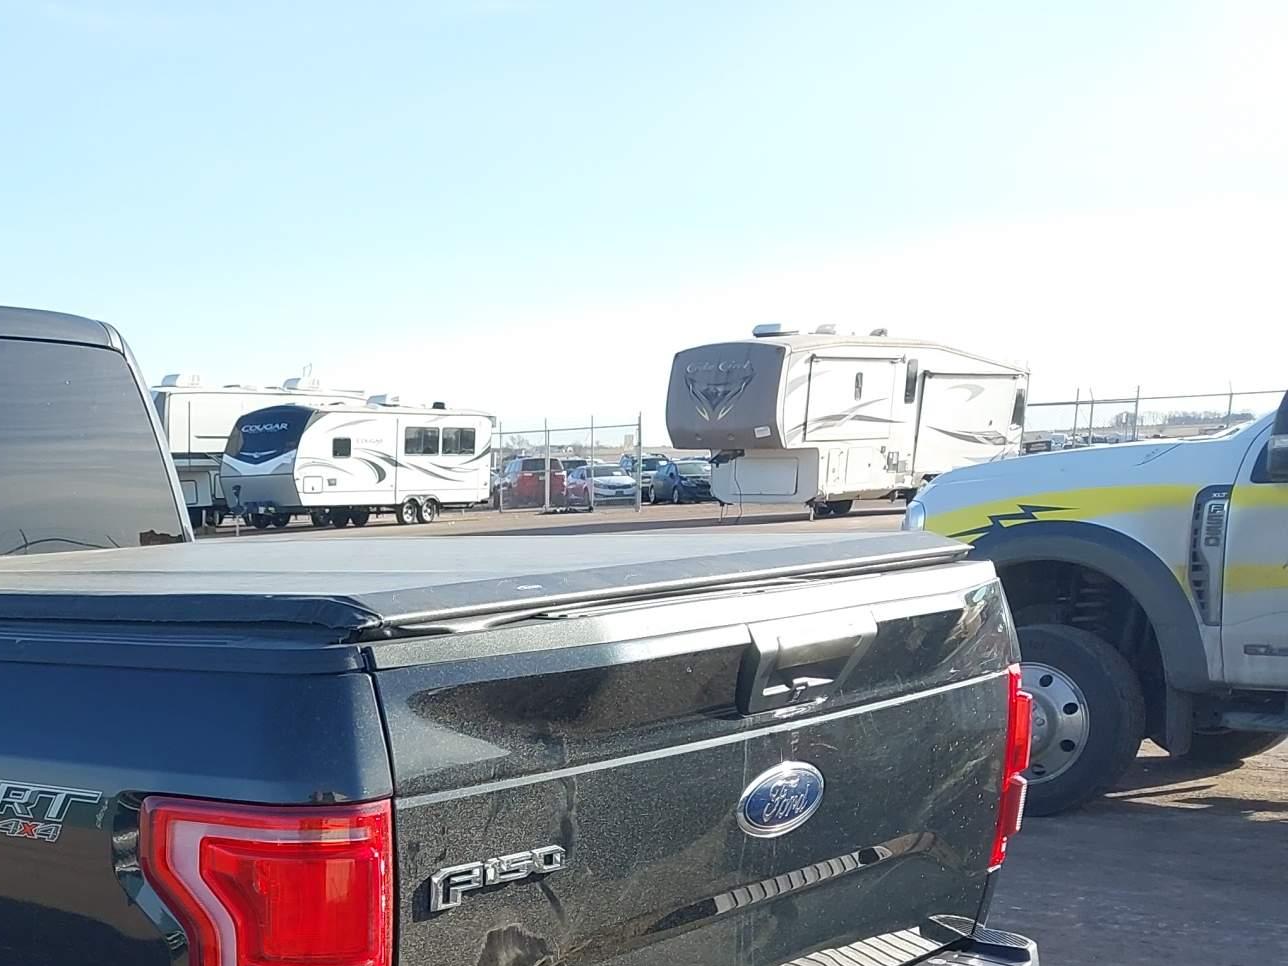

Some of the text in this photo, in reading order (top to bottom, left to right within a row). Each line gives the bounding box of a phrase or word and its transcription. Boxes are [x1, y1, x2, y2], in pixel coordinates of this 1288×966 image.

[241, 423, 289, 433] COUGAR
[762, 775, 811, 823] Ford
[430, 844, 566, 912] F150
